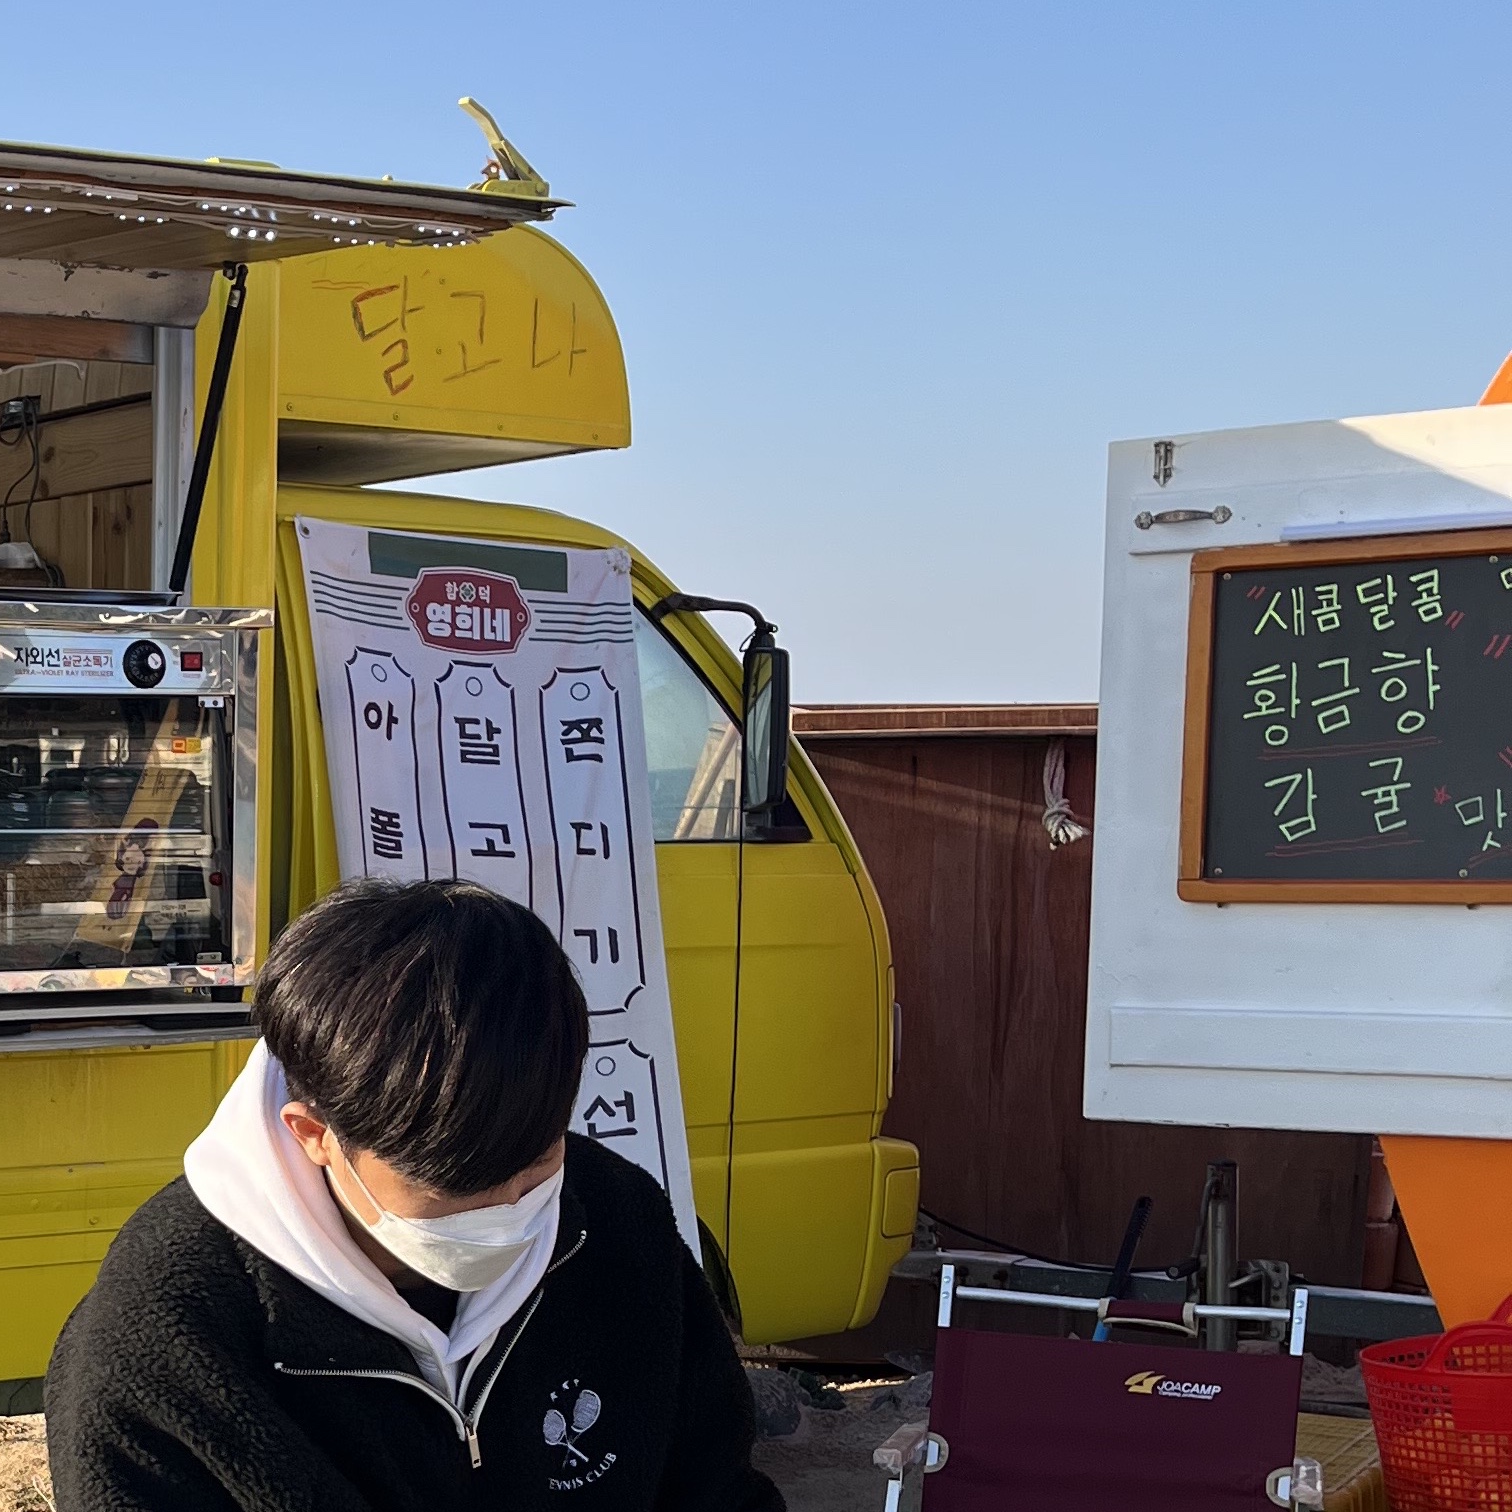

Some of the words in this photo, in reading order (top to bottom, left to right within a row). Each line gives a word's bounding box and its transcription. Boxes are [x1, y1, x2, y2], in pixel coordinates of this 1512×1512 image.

[351, 275, 587, 396] 달고나
[425, 601, 511, 643] 영희네
[14, 646, 61, 668] 자외선
[62, 654, 114, 669] 살균소독기
[1243, 647, 1441, 746] 황금향
[559, 716, 620, 965] 쫀디기
[1156, 1380, 1222, 1396] JOACAMP
[585, 1451, 617, 1483] CLUB
